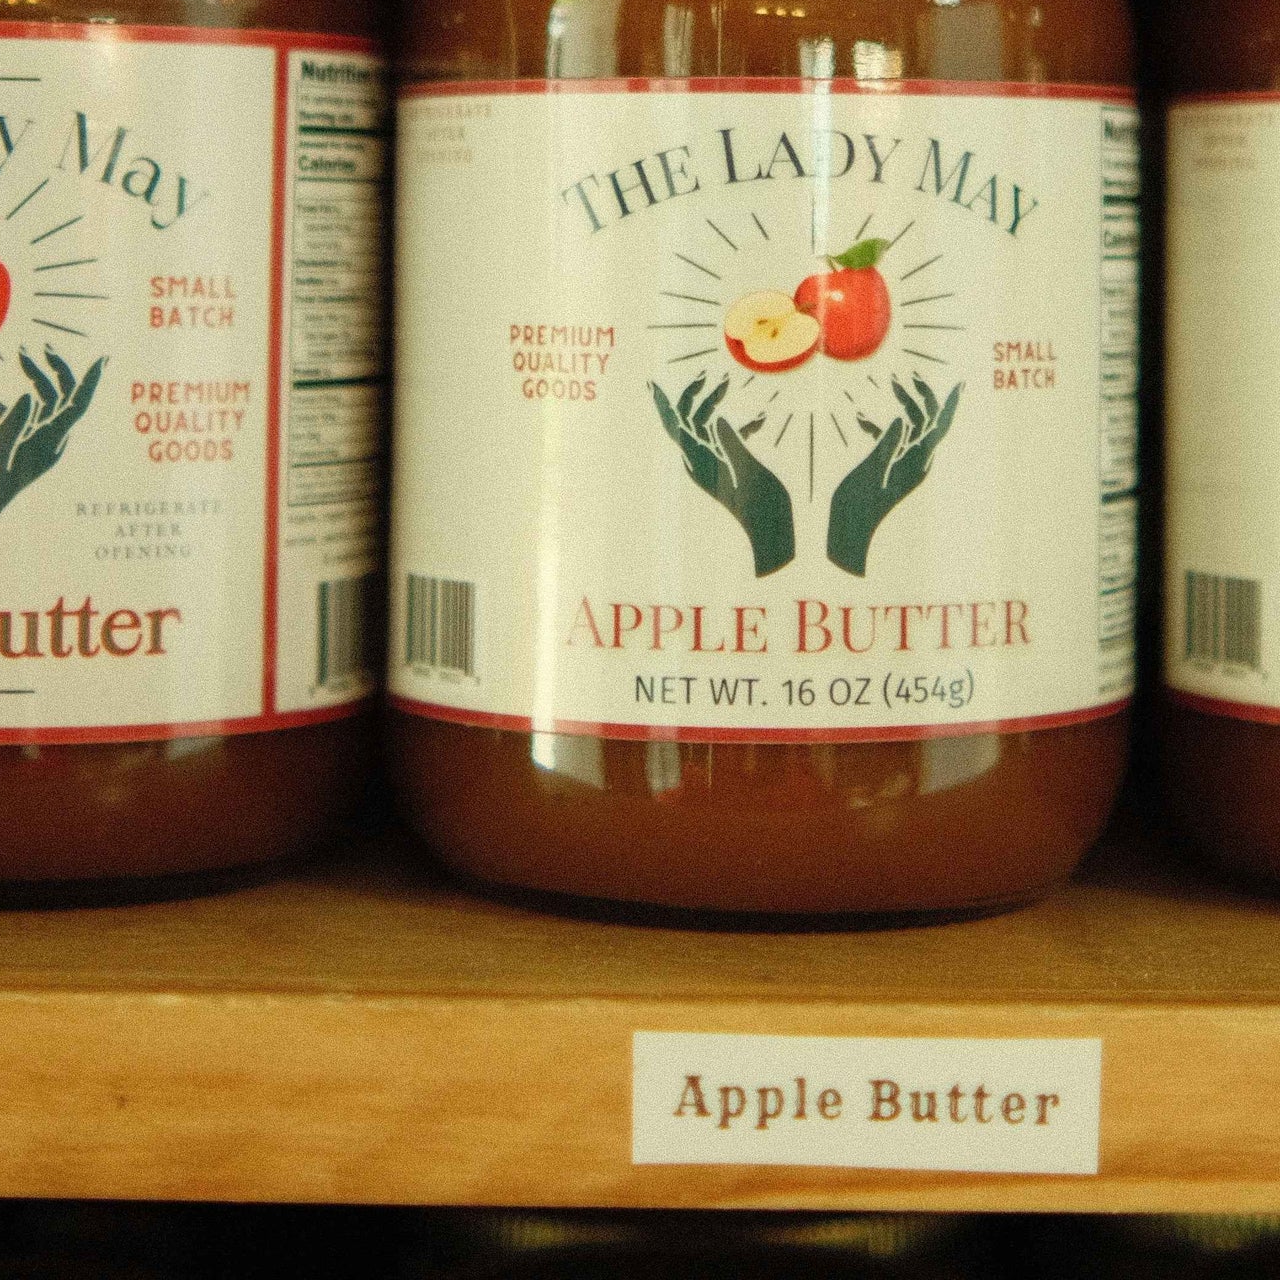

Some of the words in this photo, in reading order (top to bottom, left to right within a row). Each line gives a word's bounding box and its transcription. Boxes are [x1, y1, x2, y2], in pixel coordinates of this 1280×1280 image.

[56, 111, 212, 230] May
[561, 144, 702, 235] THE
[719, 126, 906, 184] LADY
[914, 139, 1040, 237] MAY
[149, 275, 237, 300] SMALL
[149, 305, 236, 329] BATCH
[509, 324, 616, 349] PREMIUM
[512, 349, 611, 375] QUALITY
[993, 341, 1057, 364] SMALL
[522, 376, 597, 402] GOODS
[993, 368, 1057, 391] BATCH
[130, 380, 251, 406] PREMIUM
[134, 410, 246, 434] QUALITY
[148, 439, 235, 463] GOODS
[567, 594, 769, 653] APPLE
[794, 598, 1031, 653] BUTTER
[635, 673, 695, 705] NET
[706, 674, 769, 706] WT.
[782, 674, 816, 705] 16
[828, 674, 872, 706] OZ
[882, 670, 975, 709] (454g)
[673, 1074, 844, 1130] Apple
[868, 1079, 1061, 1125] Butter
